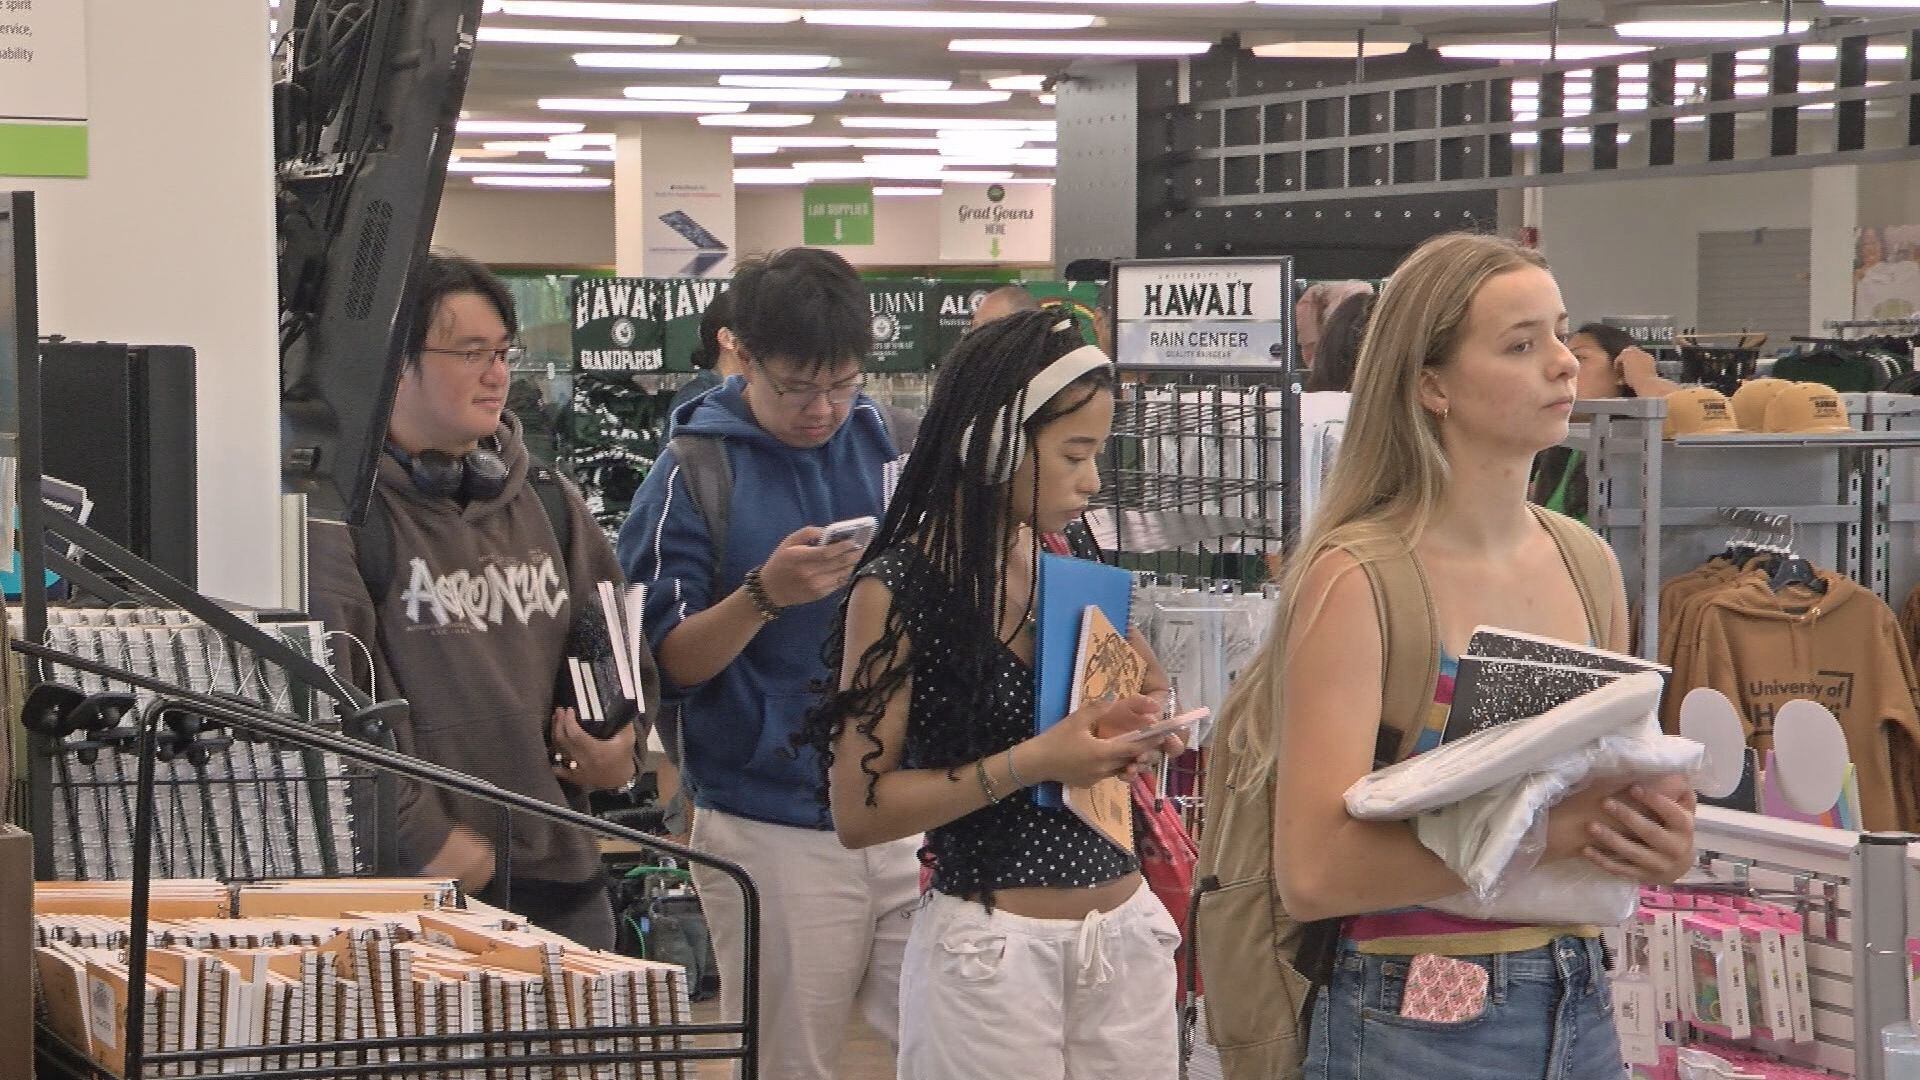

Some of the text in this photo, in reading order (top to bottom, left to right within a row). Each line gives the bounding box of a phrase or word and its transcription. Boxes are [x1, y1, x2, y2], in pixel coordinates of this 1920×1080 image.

[958, 204, 1034, 223] Grad Gowns
[985, 224, 1006, 235] HERE
[1150, 331, 1249, 348] RAIN CENTER
[1827, 680, 1845, 698] of
